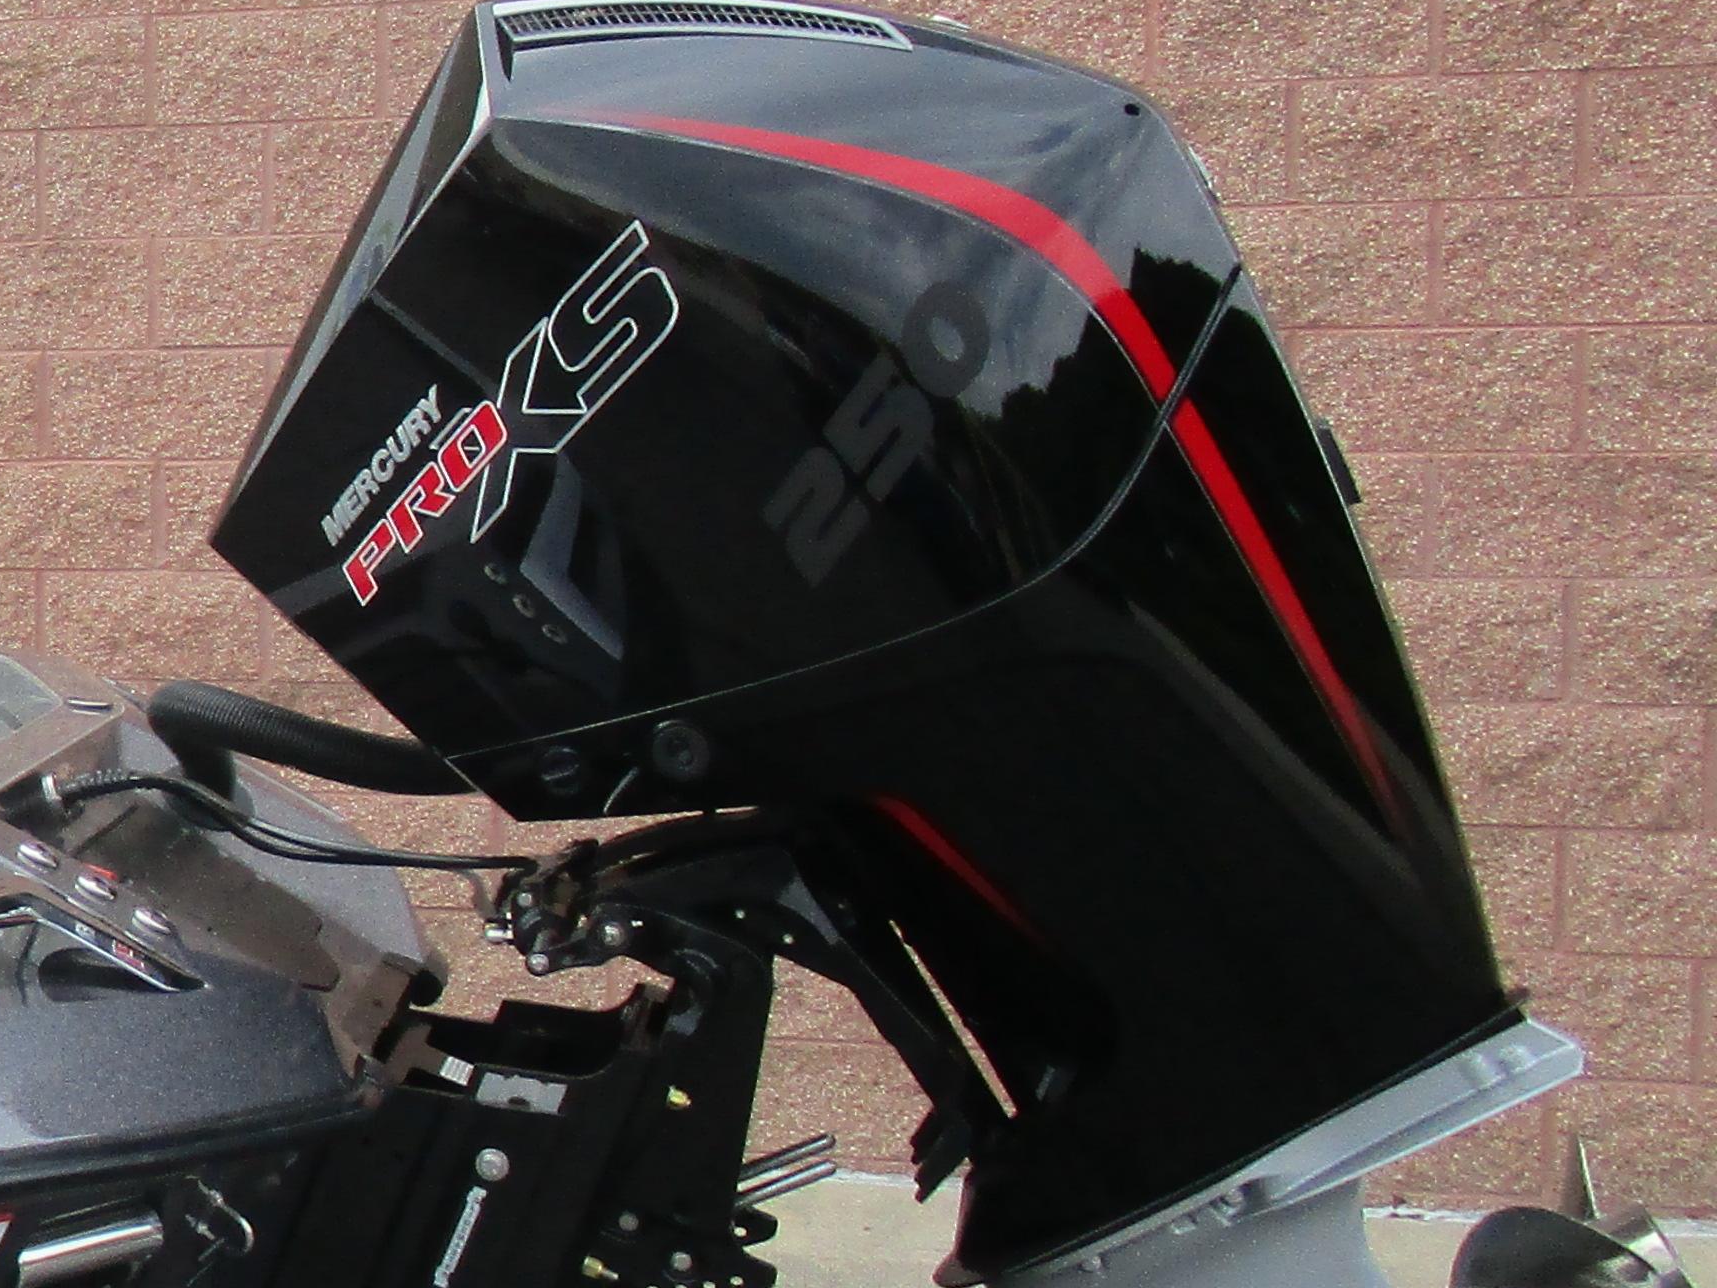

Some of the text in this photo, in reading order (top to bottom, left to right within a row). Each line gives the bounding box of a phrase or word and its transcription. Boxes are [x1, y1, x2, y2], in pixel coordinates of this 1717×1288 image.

[320, 383, 442, 547] MERCURY
[341, 399, 508, 607] PRO
[760, 278, 991, 589] 250
